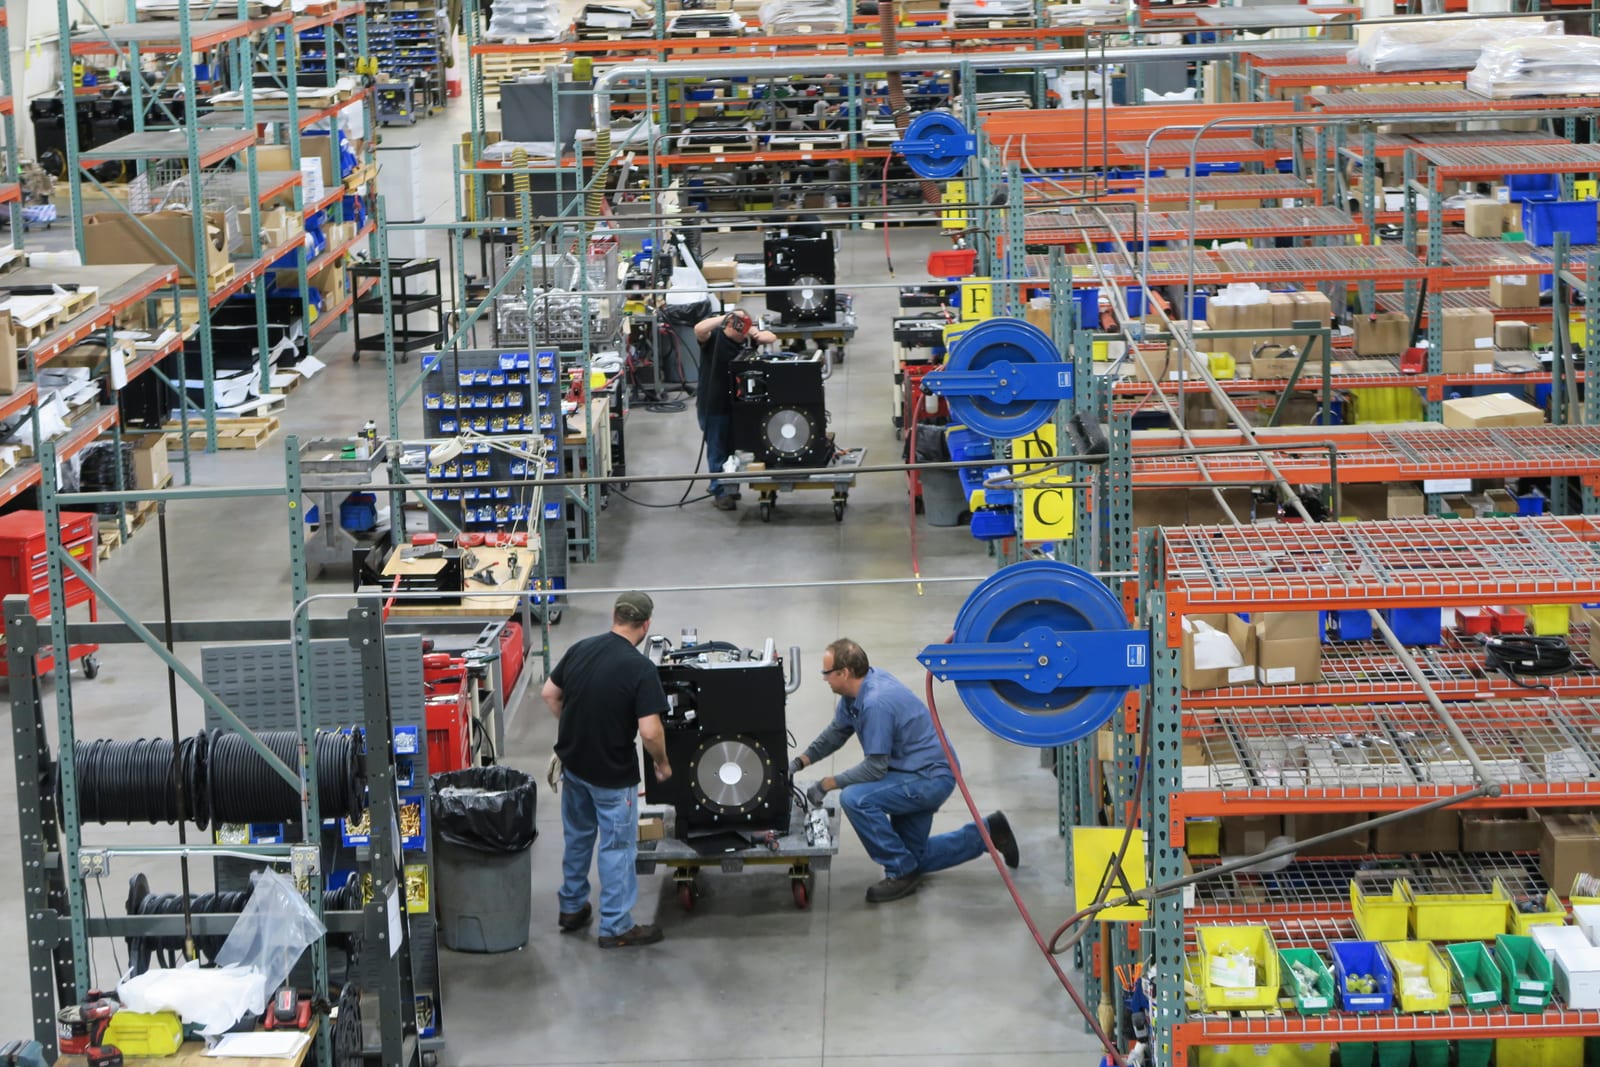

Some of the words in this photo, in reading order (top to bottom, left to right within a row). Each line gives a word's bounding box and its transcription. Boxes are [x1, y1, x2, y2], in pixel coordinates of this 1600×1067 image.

[970, 287, 988, 314] F
[1021, 439, 1054, 474] D
[1032, 489, 1064, 526] C
[1088, 851, 1145, 907] A
